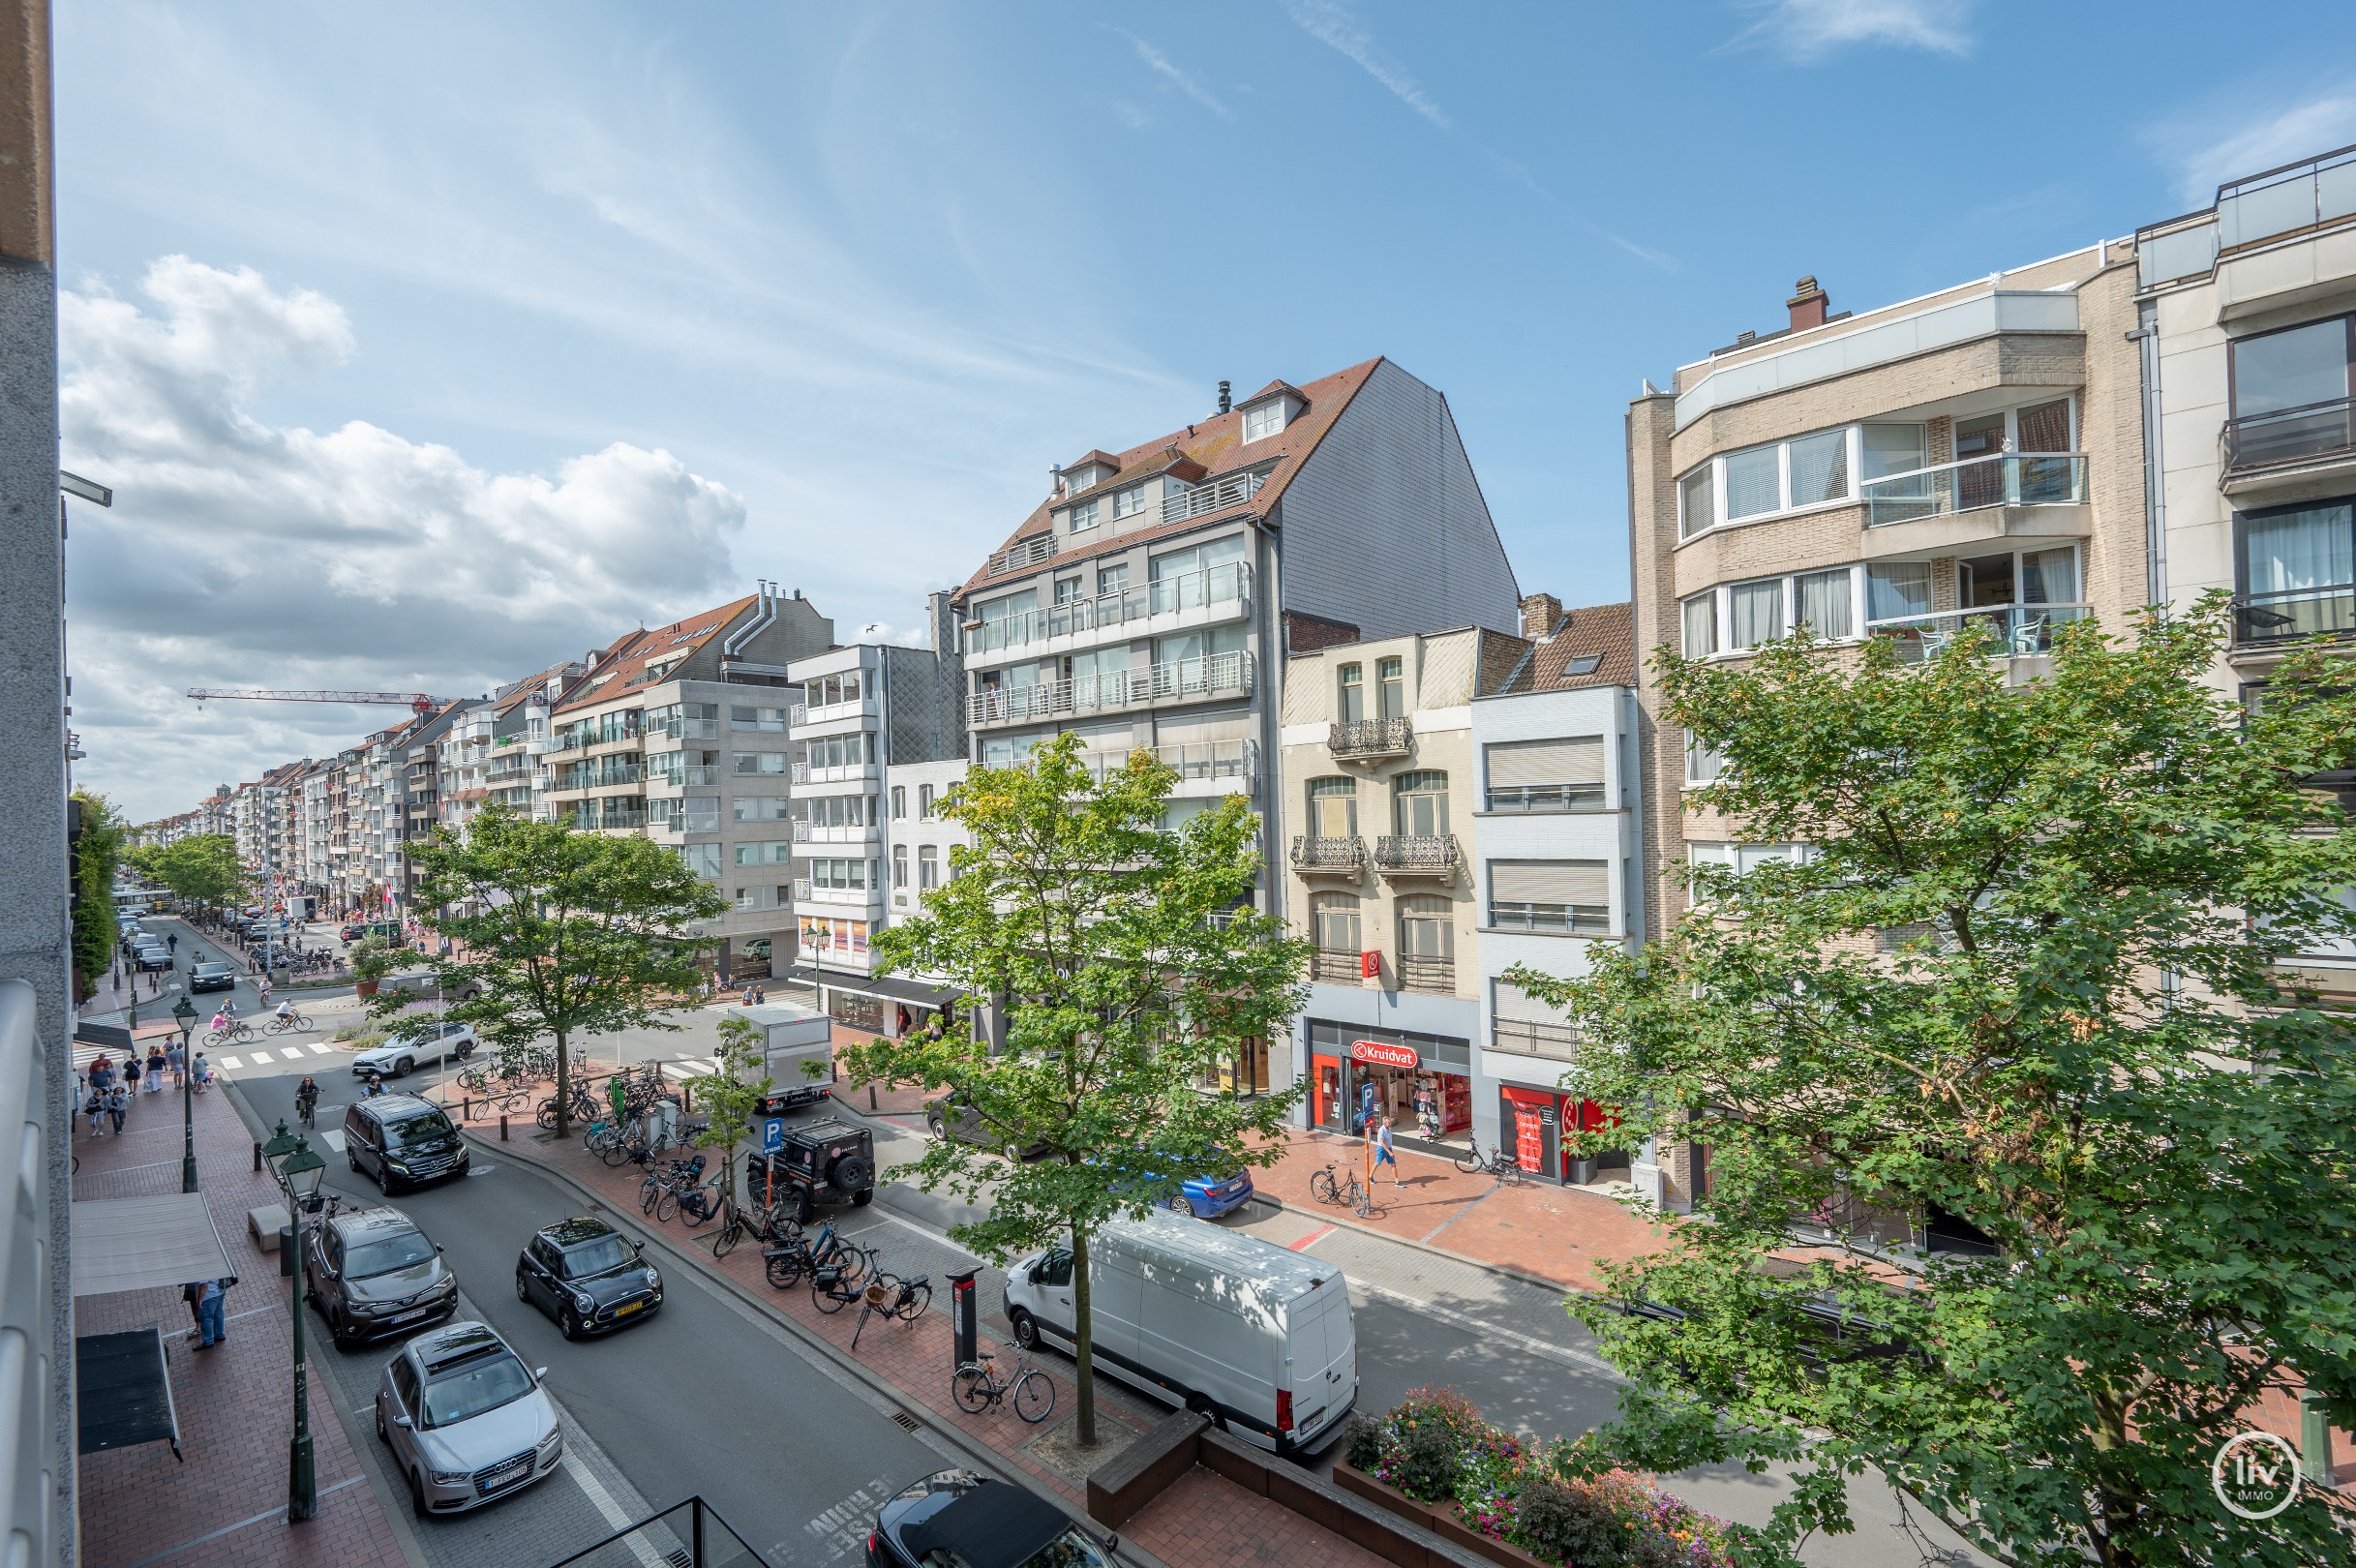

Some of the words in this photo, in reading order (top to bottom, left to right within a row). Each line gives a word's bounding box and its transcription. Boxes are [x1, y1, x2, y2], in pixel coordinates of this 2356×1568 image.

[1367, 1046, 1412, 1064] Kruidvat
[1364, 1088, 1373, 1107] P
[767, 1123, 780, 1142] P
